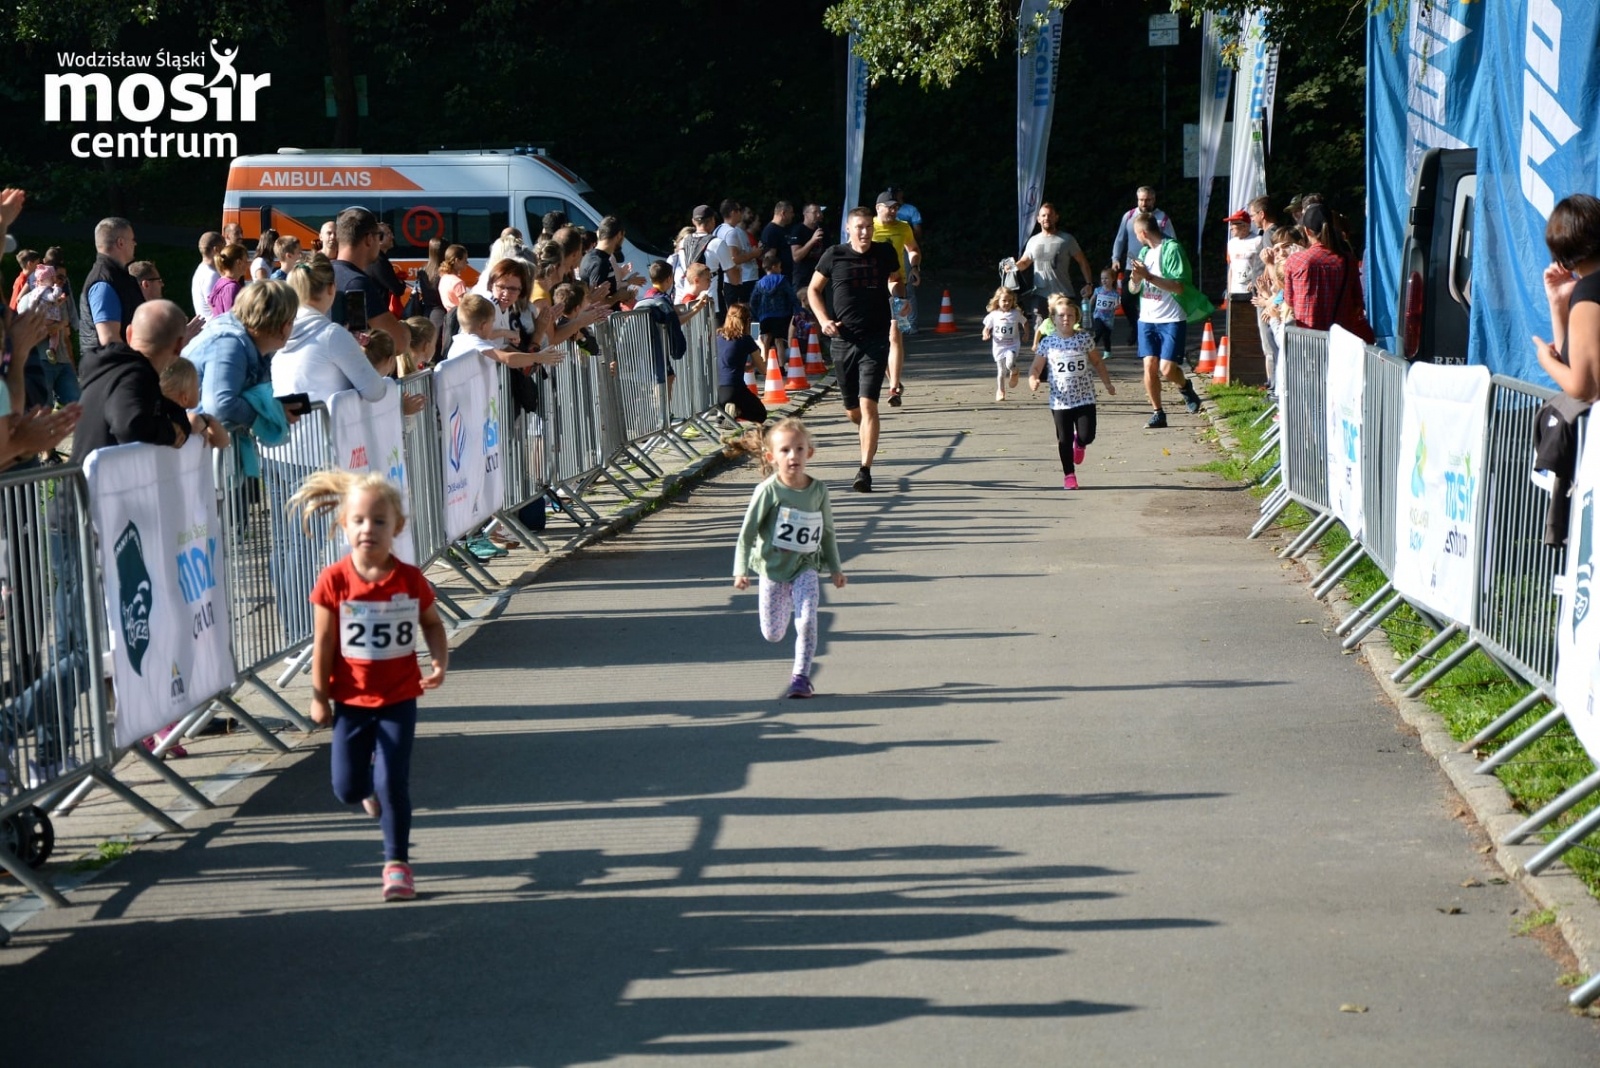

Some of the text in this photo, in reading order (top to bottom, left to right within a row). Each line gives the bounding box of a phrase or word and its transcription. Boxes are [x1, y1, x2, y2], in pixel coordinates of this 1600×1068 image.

[259, 171, 372, 187] AMBULANS
[1097, 300, 1113, 308] 267
[995, 325, 1014, 335] 261
[1057, 360, 1085, 373] 265
[777, 523, 821, 545] 264
[346, 620, 414, 649] 258
